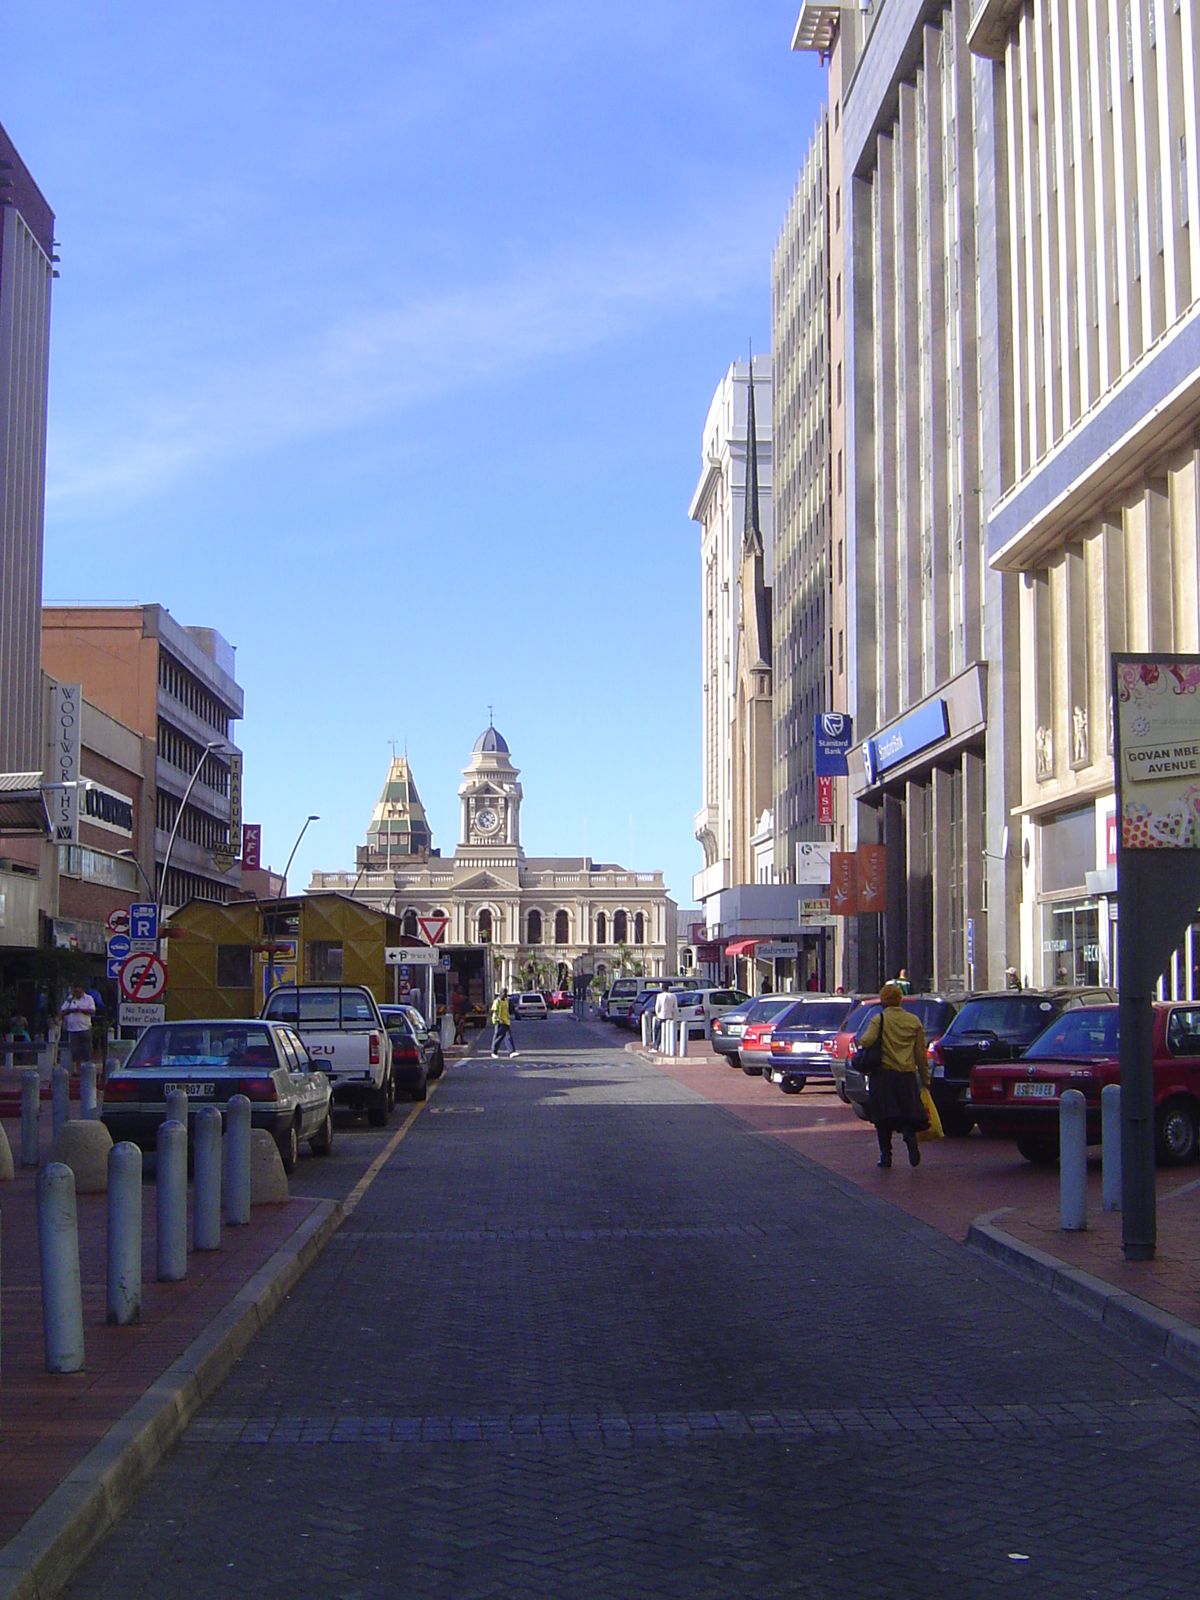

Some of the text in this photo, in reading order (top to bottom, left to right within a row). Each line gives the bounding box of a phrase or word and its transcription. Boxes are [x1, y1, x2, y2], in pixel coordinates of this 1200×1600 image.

[818, 739, 849, 747] Standard
[824, 747, 841, 755] Bank
[1128, 745, 1199, 762] GOVAN MBE
[1148, 759, 1197, 773] AVENUE
[819, 776, 831, 815] WISE
[246, 829, 258, 865] KFC
[137, 921, 150, 936] R
